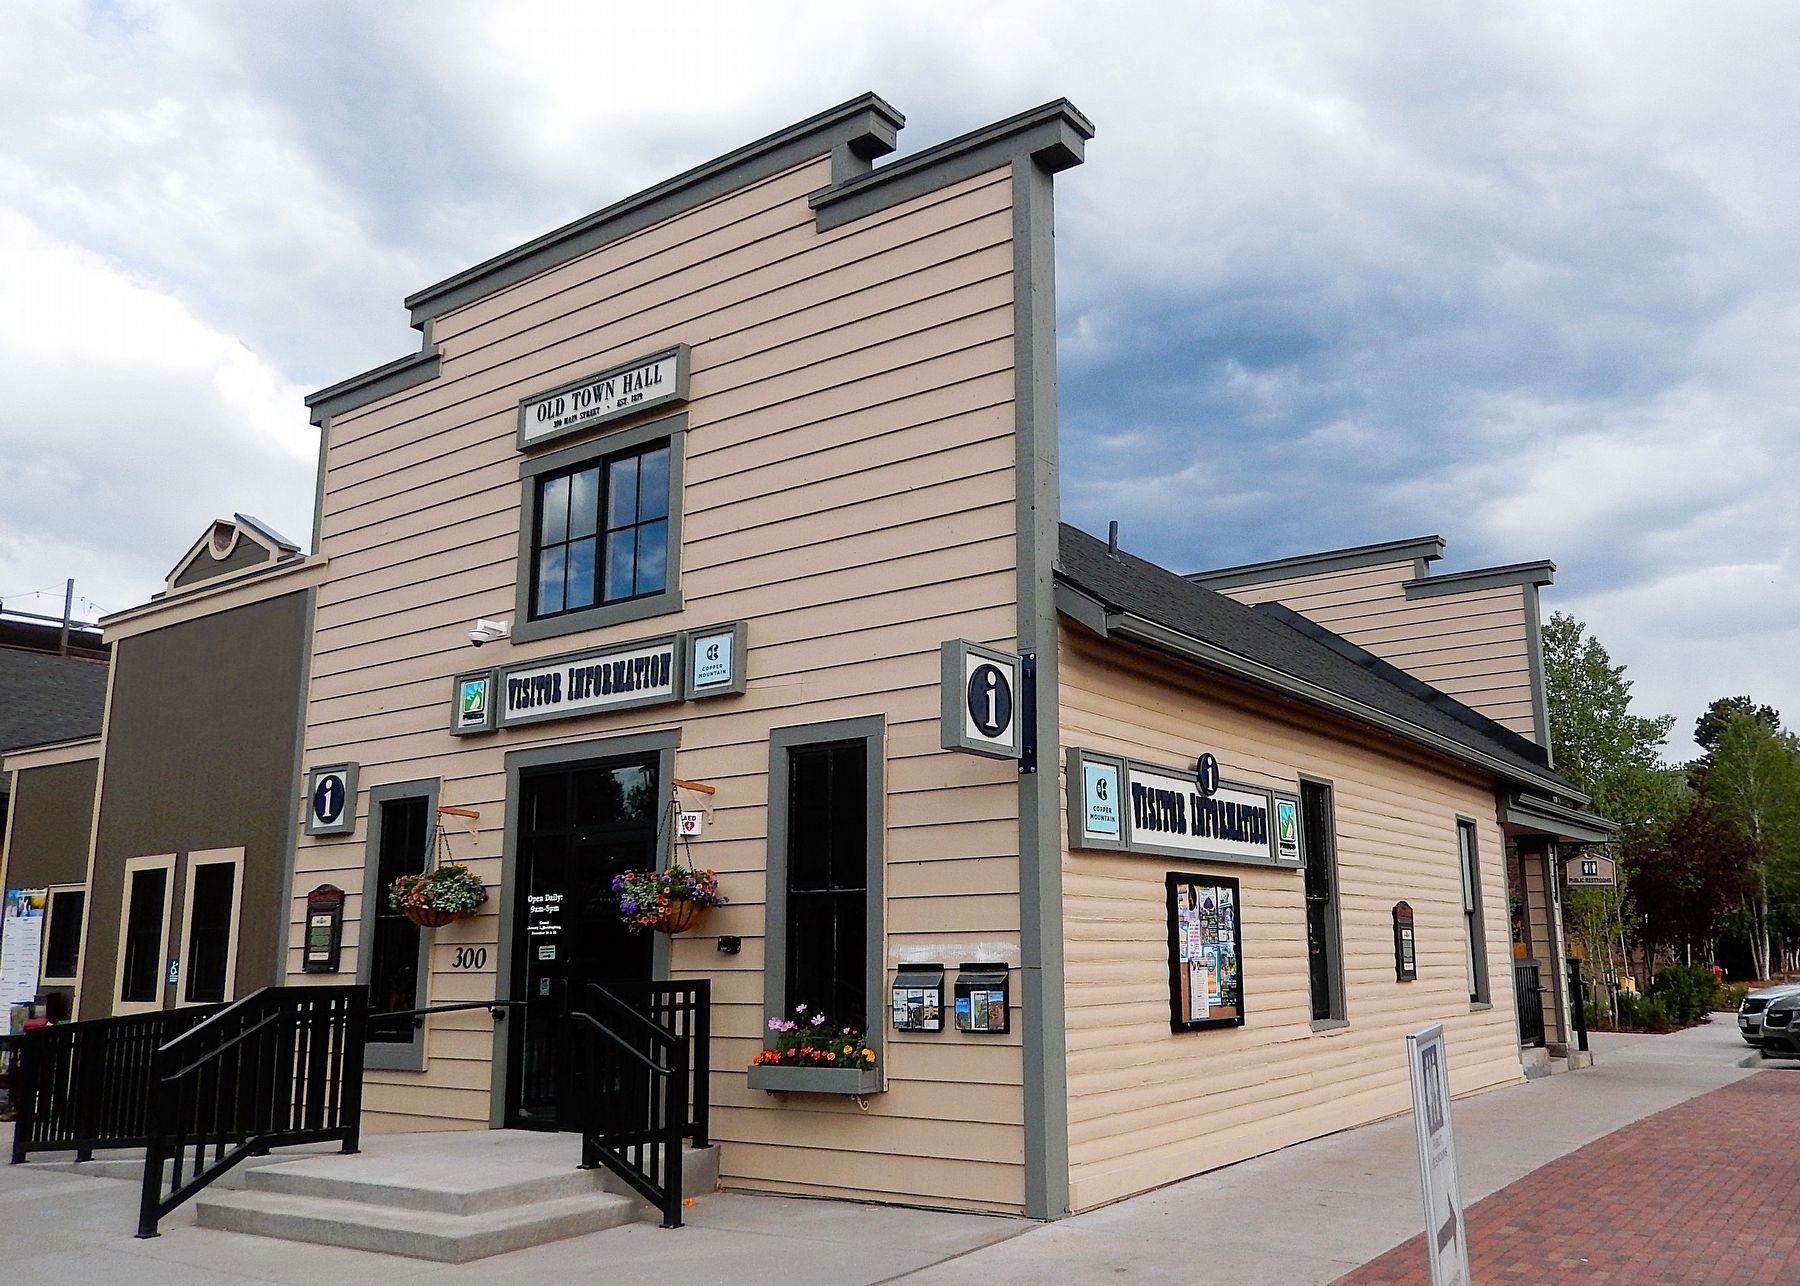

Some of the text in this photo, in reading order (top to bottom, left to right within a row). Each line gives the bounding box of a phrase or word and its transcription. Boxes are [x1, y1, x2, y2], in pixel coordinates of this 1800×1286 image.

[537, 365, 662, 422] OLD TOWN HALL
[564, 414, 578, 425] MAIN
[580, 407, 601, 419] STREET
[508, 652, 672, 711] VISITOR INFORMATION
[698, 669, 727, 678] MOUNTAIN
[1090, 814, 1116, 822] MOUNTAIN
[1093, 805, 1112, 814] COPPER
[1131, 781, 1268, 844] VISITOR INFORMATION
[528, 893, 563, 904] Open Daily:
[452, 946, 487, 969] 300
